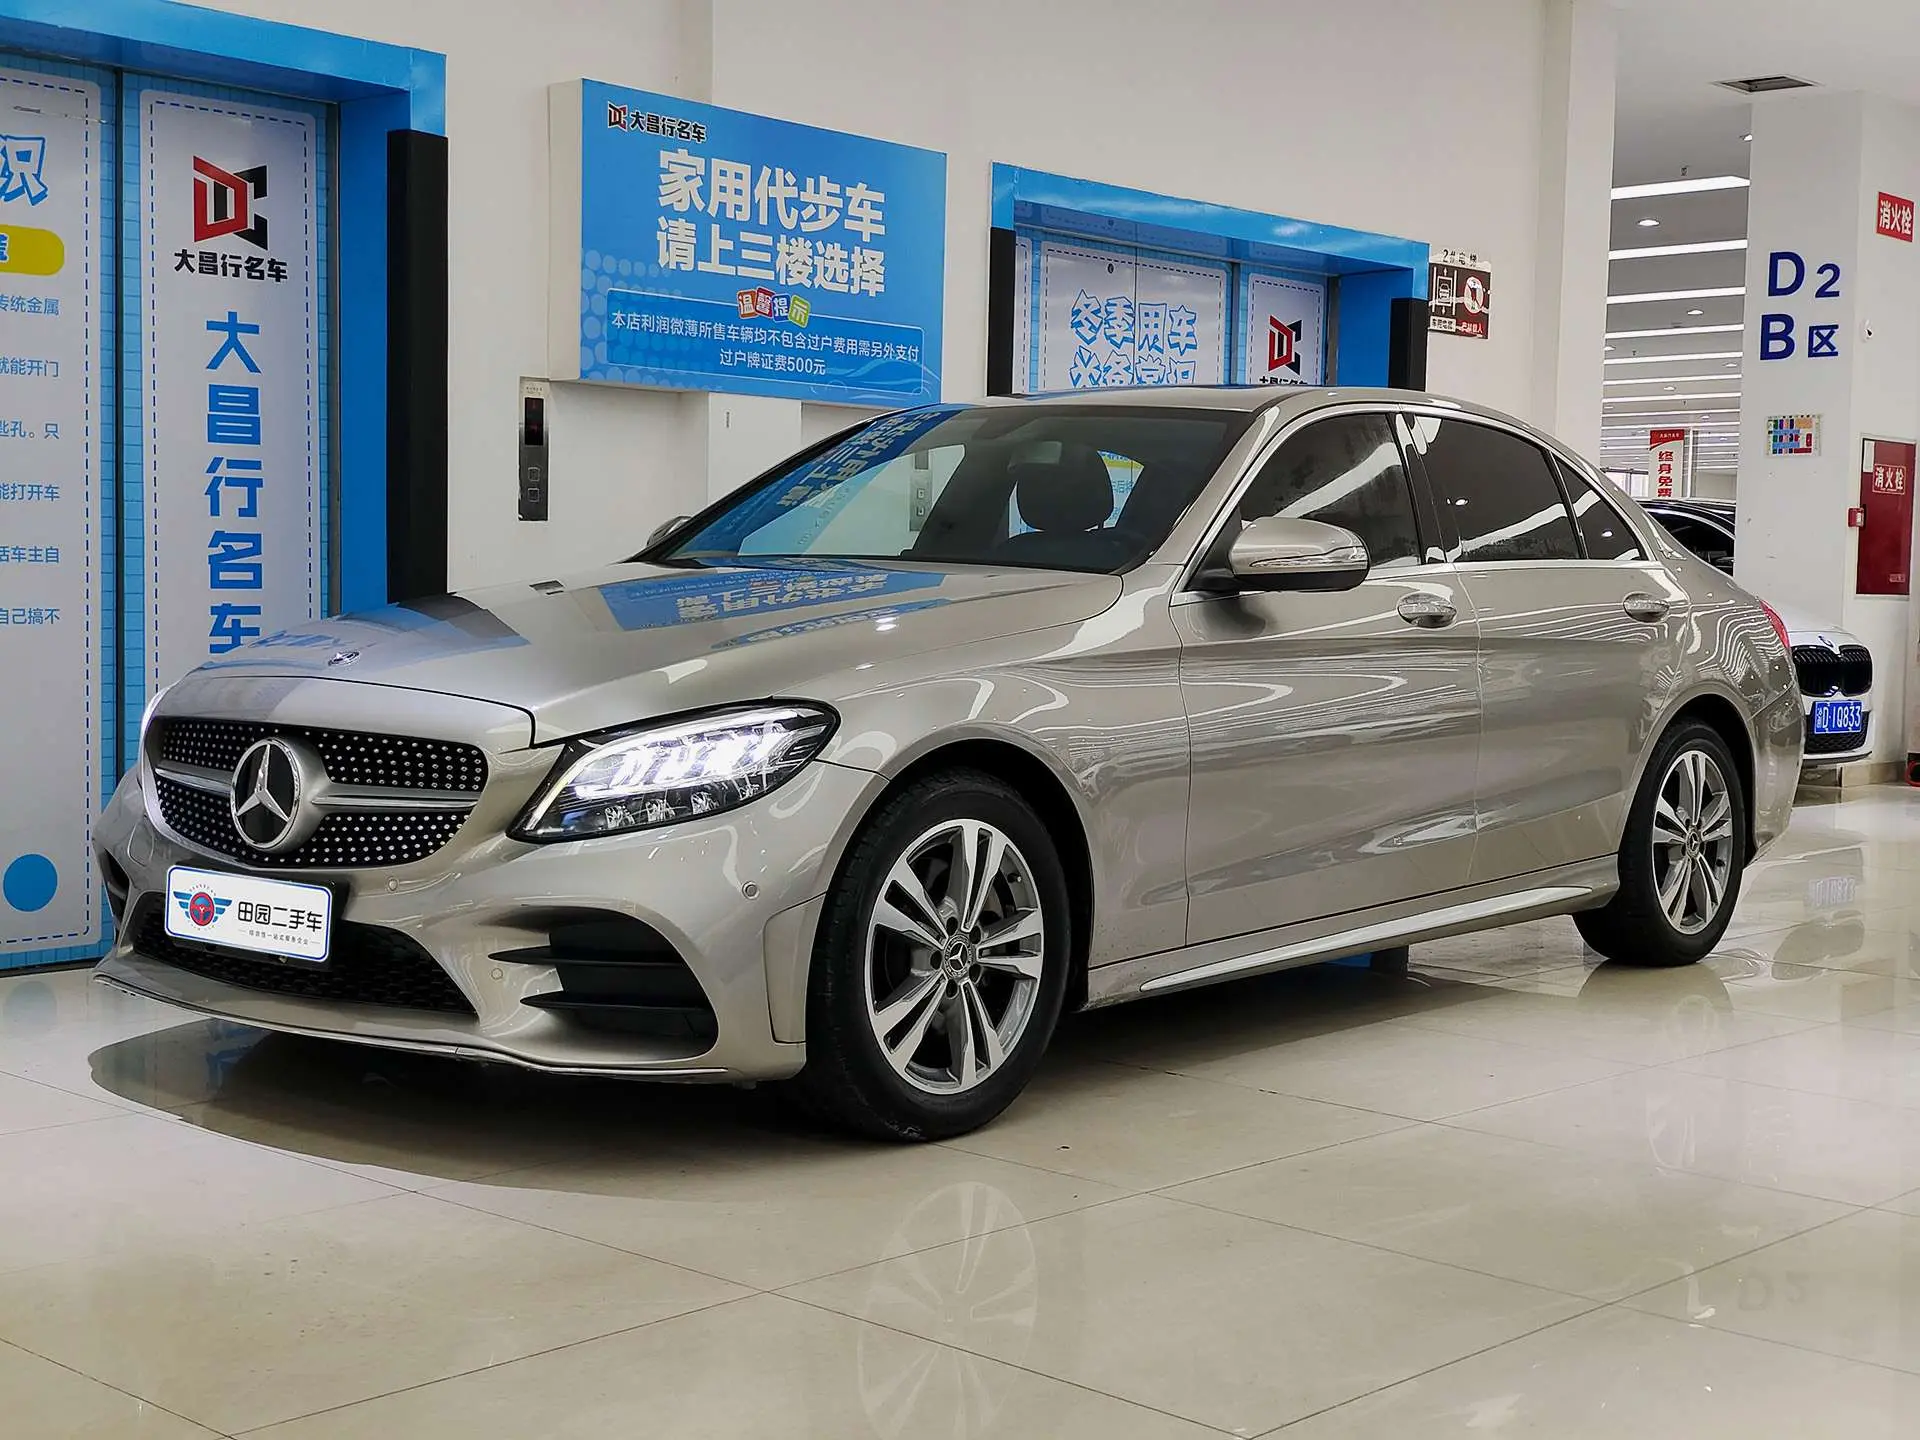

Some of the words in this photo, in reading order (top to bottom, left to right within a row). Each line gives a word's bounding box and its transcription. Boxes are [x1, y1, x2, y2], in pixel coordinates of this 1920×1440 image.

[629, 109, 706, 142] 大昌行名车
[657, 148, 886, 242] 家用代步车
[1879, 199, 1912, 235] 消火栓
[174, 248, 288, 283] 大昌行名车
[656, 215, 886, 297] 请上三楼选择
[738, 290, 809, 325] 温馨提示
[1071, 288, 1198, 356] 冬季用车
[611, 308, 919, 363] 本店利润微薄所售车辆均不包含过户费用需另外支付
[720, 348, 826, 376] 过户牌证费500元
[205, 311, 264, 654] 大昌行名车
[1875, 466, 1904, 490] 消火栓
[238, 901, 323, 933] 田园二手车
